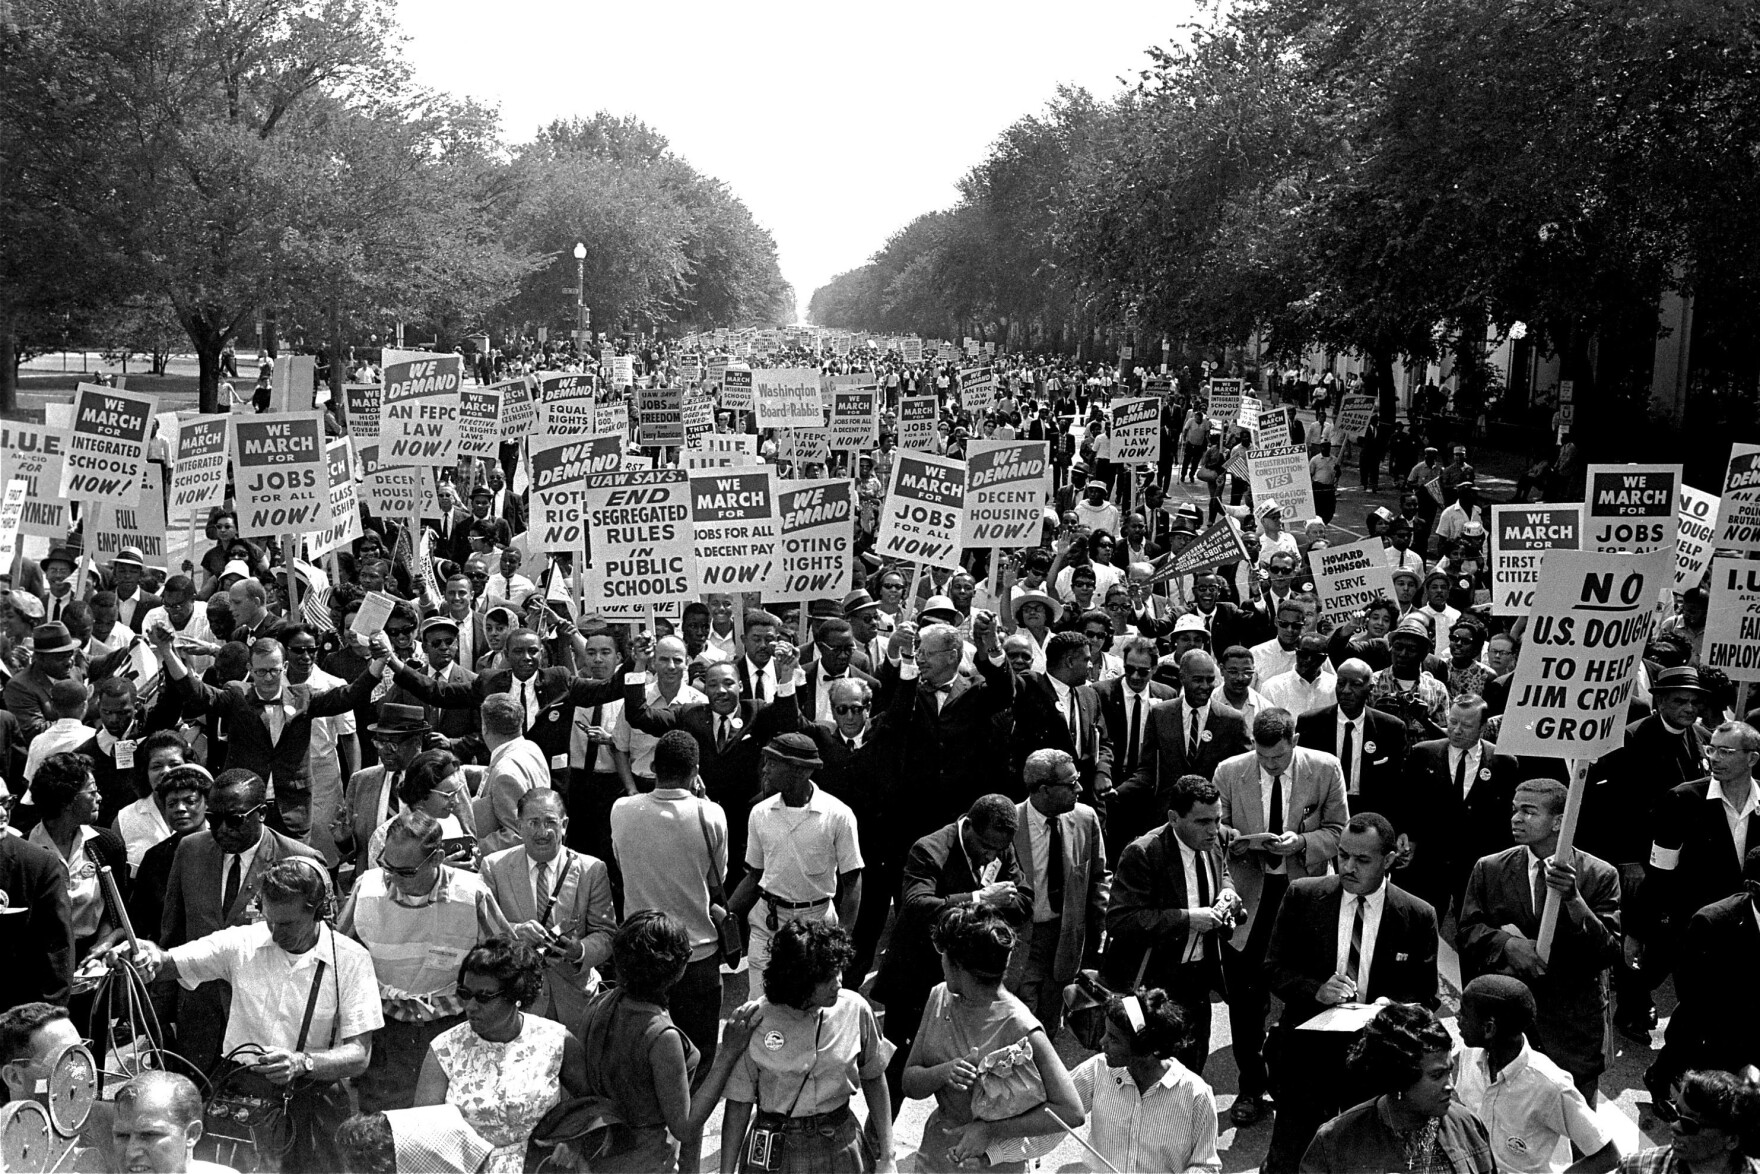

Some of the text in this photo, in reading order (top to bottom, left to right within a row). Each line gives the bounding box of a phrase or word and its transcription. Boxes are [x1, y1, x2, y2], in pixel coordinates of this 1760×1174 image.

[409, 361, 437, 378] WE
[388, 374, 456, 399] DEMAND
[558, 377, 578, 388] WE
[469, 394, 483, 402] WE
[545, 385, 592, 401] DEMAND
[758, 383, 816, 400] Washington
[104, 398, 125, 412] WE
[388, 405, 456, 420] AN FEPC
[511, 404, 532, 413] CLASS
[550, 404, 587, 415] EQUAL
[641, 400, 667, 410] JOBS
[790, 402, 819, 417] Rabbis
[838, 402, 869, 410] MARCH
[904, 407, 932, 415] MARCH
[82, 408, 142, 430] MARCH
[549, 415, 588, 424] RIGHTS
[641, 413, 680, 422] FREEDOM
[1115, 408, 1157, 426] DEMAND
[1261, 416, 1283, 426] MARCH
[97, 426, 121, 436] FOR
[194, 424, 209, 435] WE
[266, 424, 290, 436] WE
[403, 422, 443, 437] LAW
[469, 427, 498, 435] RIGHTS
[904, 422, 932, 432] JOBS
[1115, 427, 1157, 437] AN FEPC
[1339, 424, 1364, 432] NOW!
[1, 429, 64, 455] I.U.E.
[181, 432, 221, 450] MARCH
[803, 433, 826, 441] FEPC
[836, 435, 869, 445] NOW!
[903, 437, 932, 448] NOW!
[1124, 438, 1149, 446] LAW
[71, 435, 141, 458] INTEGRATED
[191, 447, 207, 455] FOR
[245, 436, 313, 454] MARCH
[391, 439, 452, 457] NOW!
[561, 442, 594, 463] WE
[1249, 445, 1305, 458] UAW SAYS:
[176, 456, 223, 473] INTEGRATED
[268, 454, 295, 462] FOR
[993, 448, 1022, 466] WE
[18, 462, 42, 472] FOR
[69, 454, 138, 476] SCHOOLS
[538, 453, 618, 486] DEMAND
[925, 465, 946, 479] WE
[175, 471, 221, 487] SCHOOLS
[248, 469, 315, 491] JOBS
[590, 471, 685, 487] UAW SAYS:
[972, 460, 1042, 487] DEMAND
[1267, 474, 1288, 488] YES
[69, 474, 132, 496] NOW!
[716, 478, 740, 491] WE
[901, 474, 963, 497] MARCH
[1623, 476, 1646, 488] WE
[175, 484, 218, 506] NOW!
[252, 492, 315, 503] FOR ALL
[605, 488, 670, 507] END
[697, 491, 764, 510] MARCH
[793, 488, 824, 509] WE
[918, 492, 942, 502] FOR
[978, 491, 1036, 503] DECENT
[1598, 490, 1667, 505] MARCH
[1731, 491, 1753, 501] AN
[251, 502, 321, 528] NOW!
[592, 505, 688, 527] SEGREGATED
[718, 509, 745, 518] FOR
[895, 504, 956, 529] JOBS
[970, 508, 1040, 520] HOUSING
[1526, 513, 1550, 524] WE
[1619, 507, 1645, 515] FOR
[115, 509, 137, 529] FULL
[606, 524, 675, 544] RULES
[694, 525, 774, 540] JOBS FOR ALL
[894, 522, 950, 540] FOR ALL
[973, 521, 1036, 539] NOW!
[1504, 525, 1573, 540] MARCH
[1596, 524, 1664, 542] JOBS
[704, 543, 775, 557] DECENT PAY
[782, 537, 846, 553] OTING
[887, 535, 953, 560] NOW!
[1203, 545, 1223, 558] JOBS
[1224, 540, 1235, 549] FOR
[1525, 541, 1552, 549] FOR
[629, 547, 654, 558] IN
[1219, 547, 1240, 559] MARCH
[1321, 549, 1364, 565] HOWARD
[606, 556, 683, 577] PUBLIC
[1499, 556, 1536, 568] FIRST
[703, 560, 772, 584] NOW!
[603, 576, 688, 598] SCHOOLS
[1334, 575, 1366, 591] SERVE
[1580, 571, 1644, 605] NO
[1532, 610, 1653, 648] U.S. DOUGH
[1541, 654, 1635, 682] TO HELP
[1517, 678, 1633, 711] JIM CROW
[1535, 714, 1615, 742] GROW
